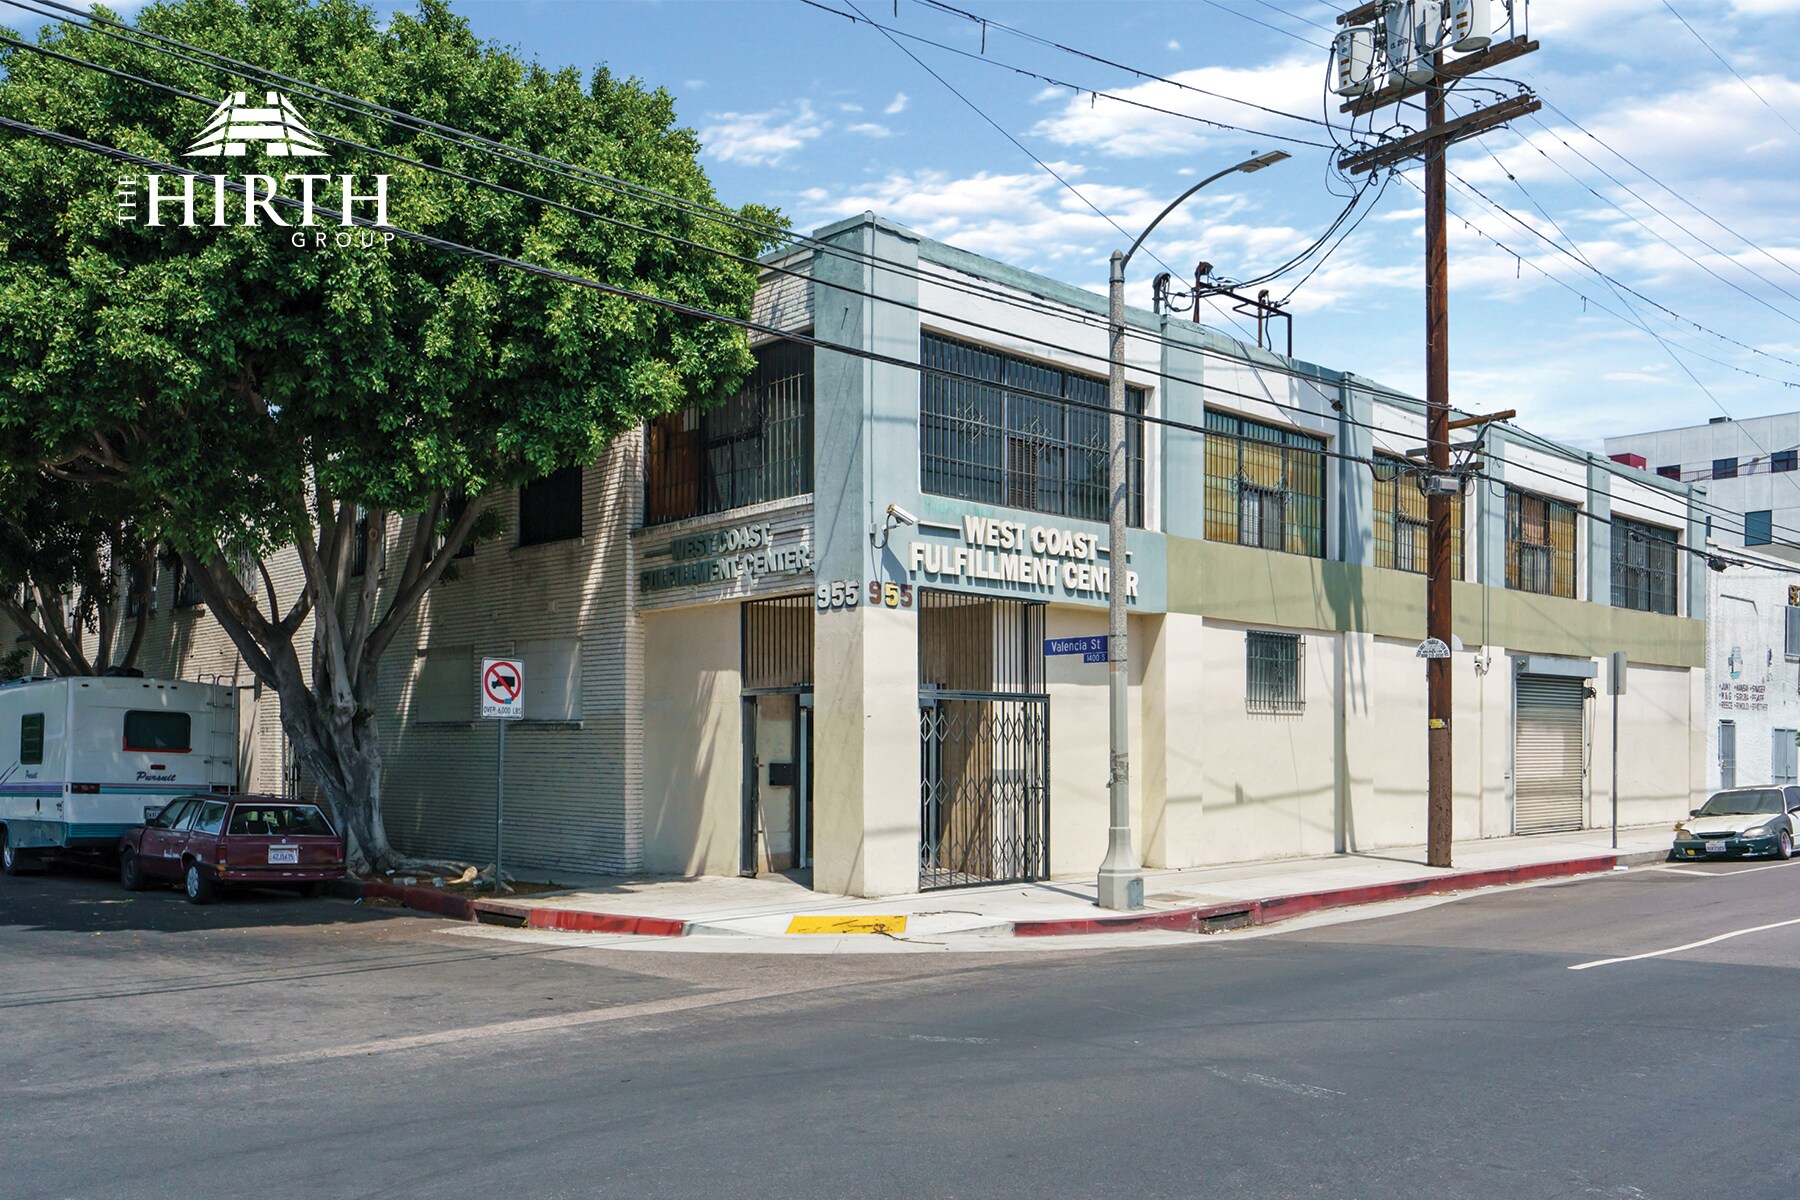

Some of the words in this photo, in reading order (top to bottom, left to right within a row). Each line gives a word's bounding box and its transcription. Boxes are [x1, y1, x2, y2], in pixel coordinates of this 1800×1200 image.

[671, 533, 713, 561] WEST
[718, 522, 770, 553] COAST
[962, 514, 1026, 550] WEST
[1030, 525, 1098, 560] COAST
[743, 544, 810, 577] CENTER
[909, 542, 1058, 586] FULFILLMENT
[1062, 562, 1139, 597] CENTR
[817, 581, 859, 608] 955
[869, 580, 913, 607] 955
[1051, 640, 1087, 652] Valencia
[1091, 638, 1101, 650] St
[1086, 653, 1100, 662] 1400
[136, 771, 177, 782] Pursuit
